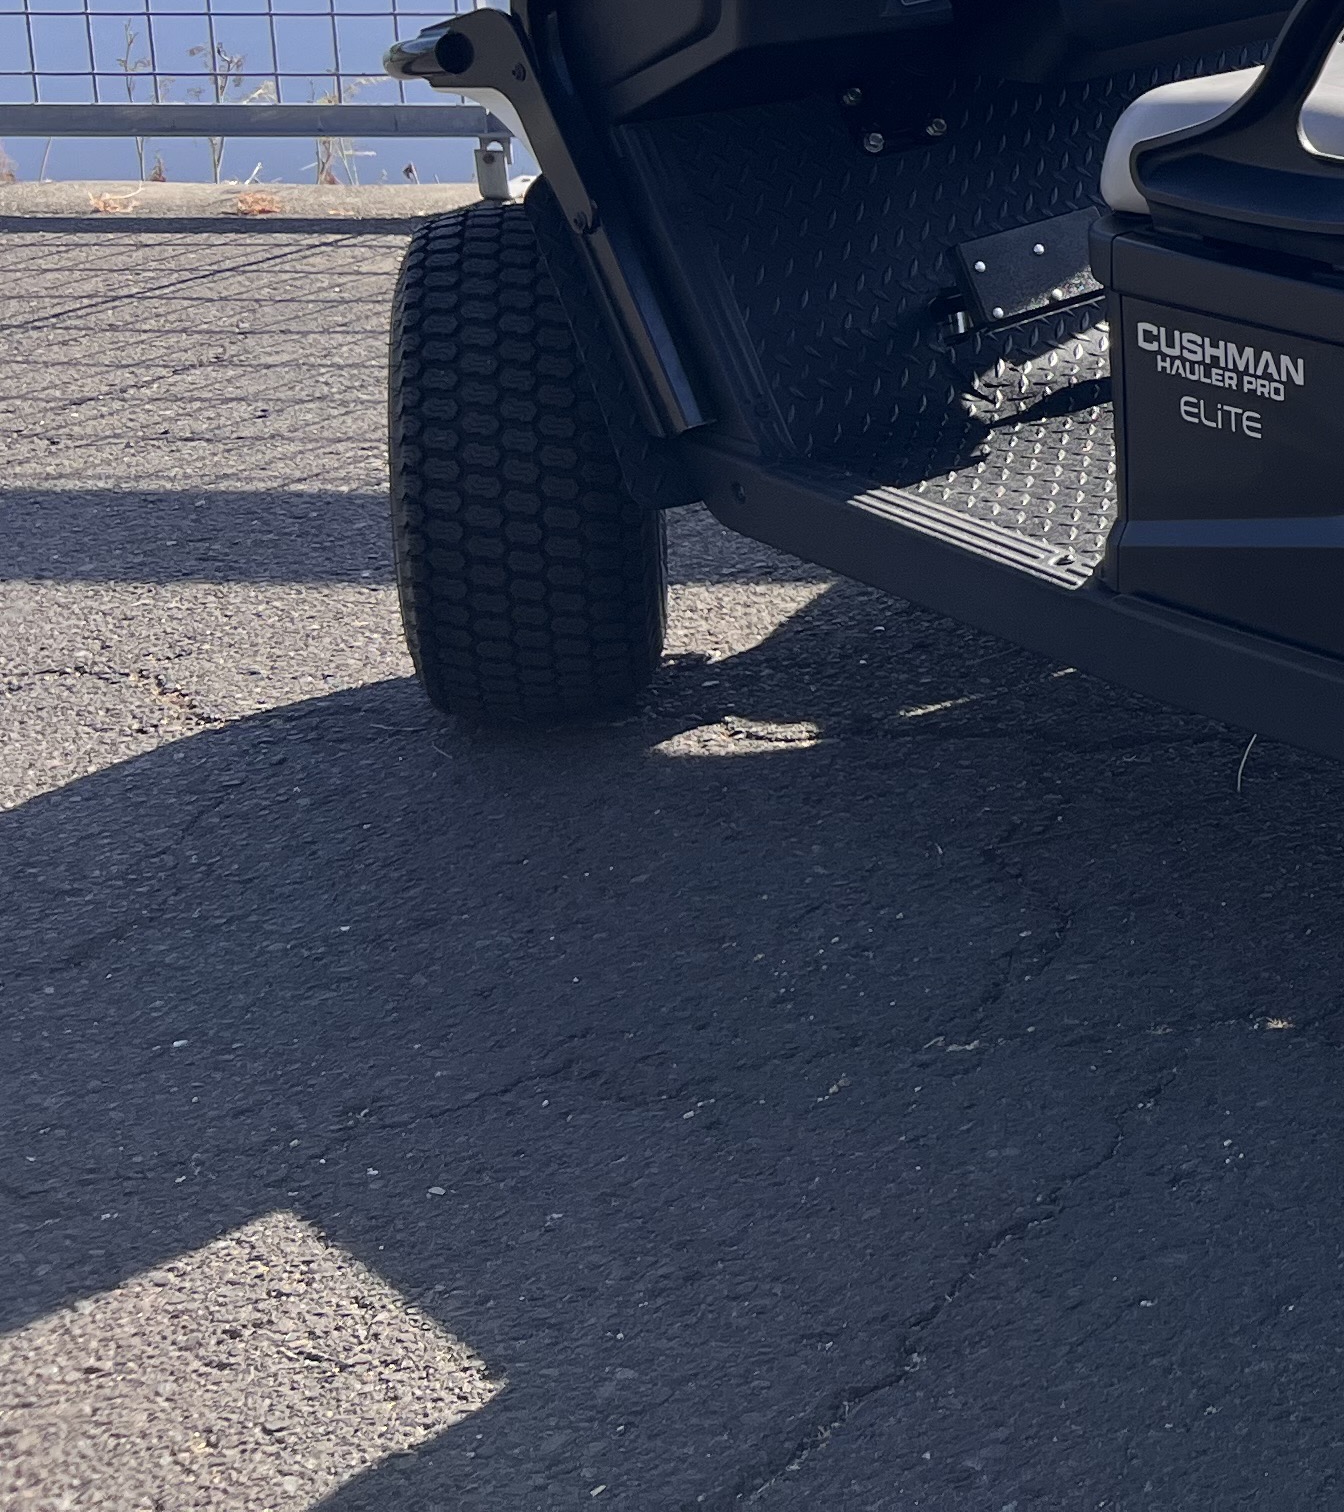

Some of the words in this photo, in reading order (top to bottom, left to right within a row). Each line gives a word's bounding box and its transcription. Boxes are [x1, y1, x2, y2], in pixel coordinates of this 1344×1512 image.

[1137, 321, 1305, 386] CUSHMAN
[1157, 355, 1238, 391] HAULER
[1243, 374, 1286, 402] PRO
